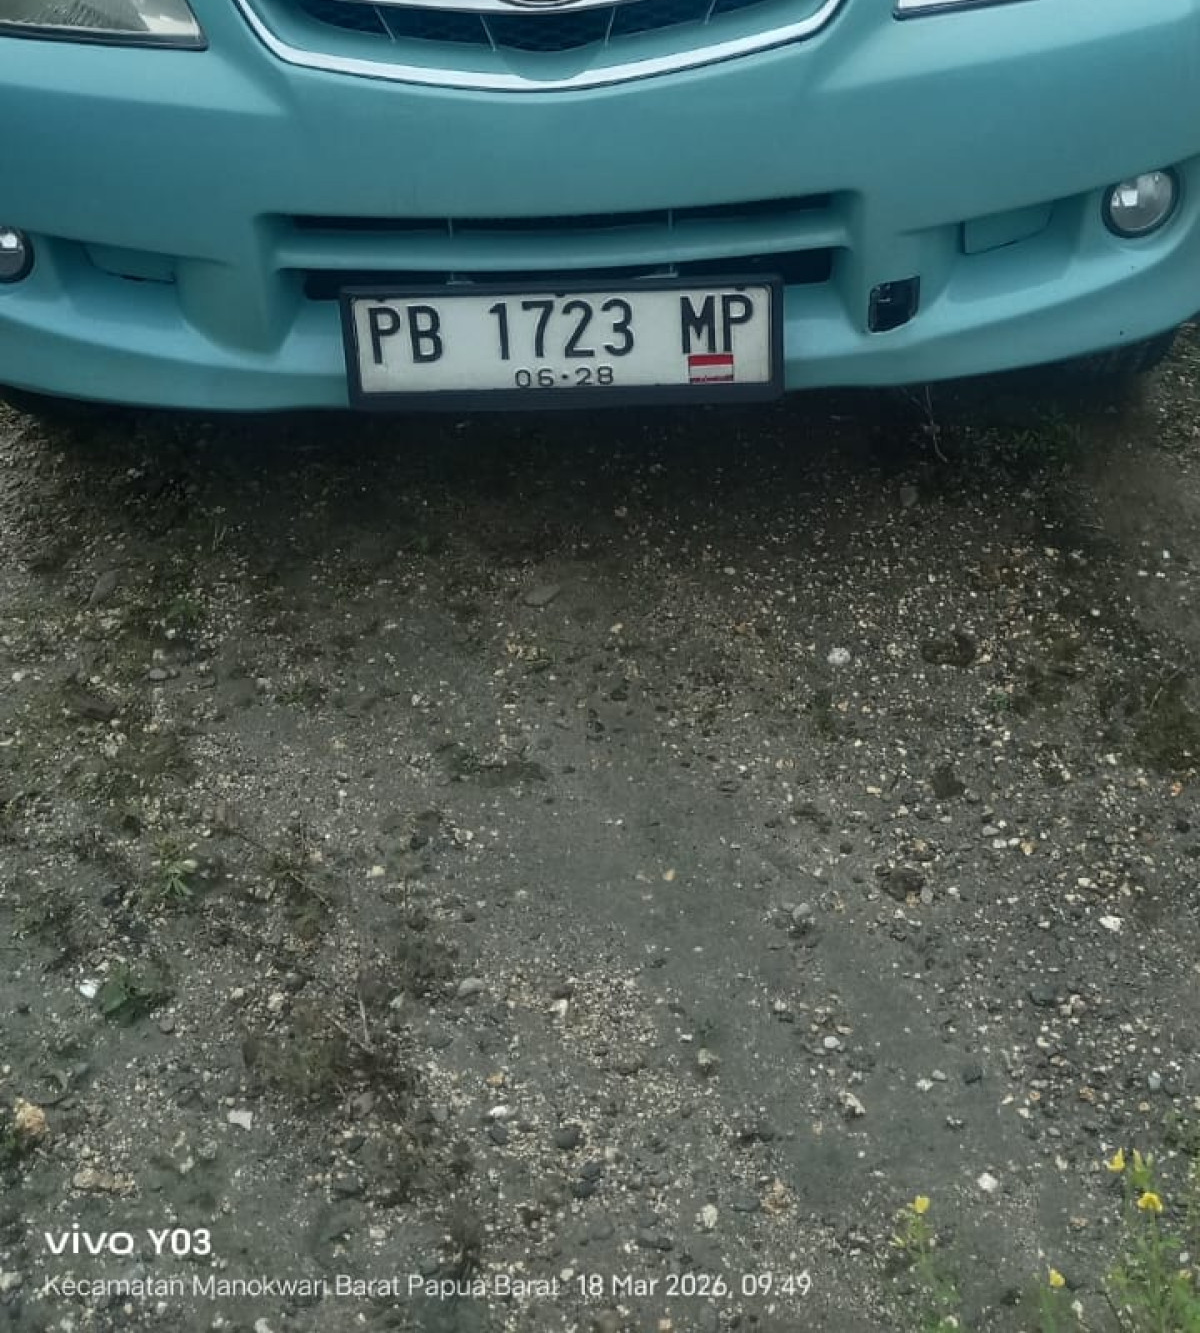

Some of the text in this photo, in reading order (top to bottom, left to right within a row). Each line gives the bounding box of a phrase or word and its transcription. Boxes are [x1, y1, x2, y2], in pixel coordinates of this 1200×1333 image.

[368, 294, 754, 365] PB 1723 MP
